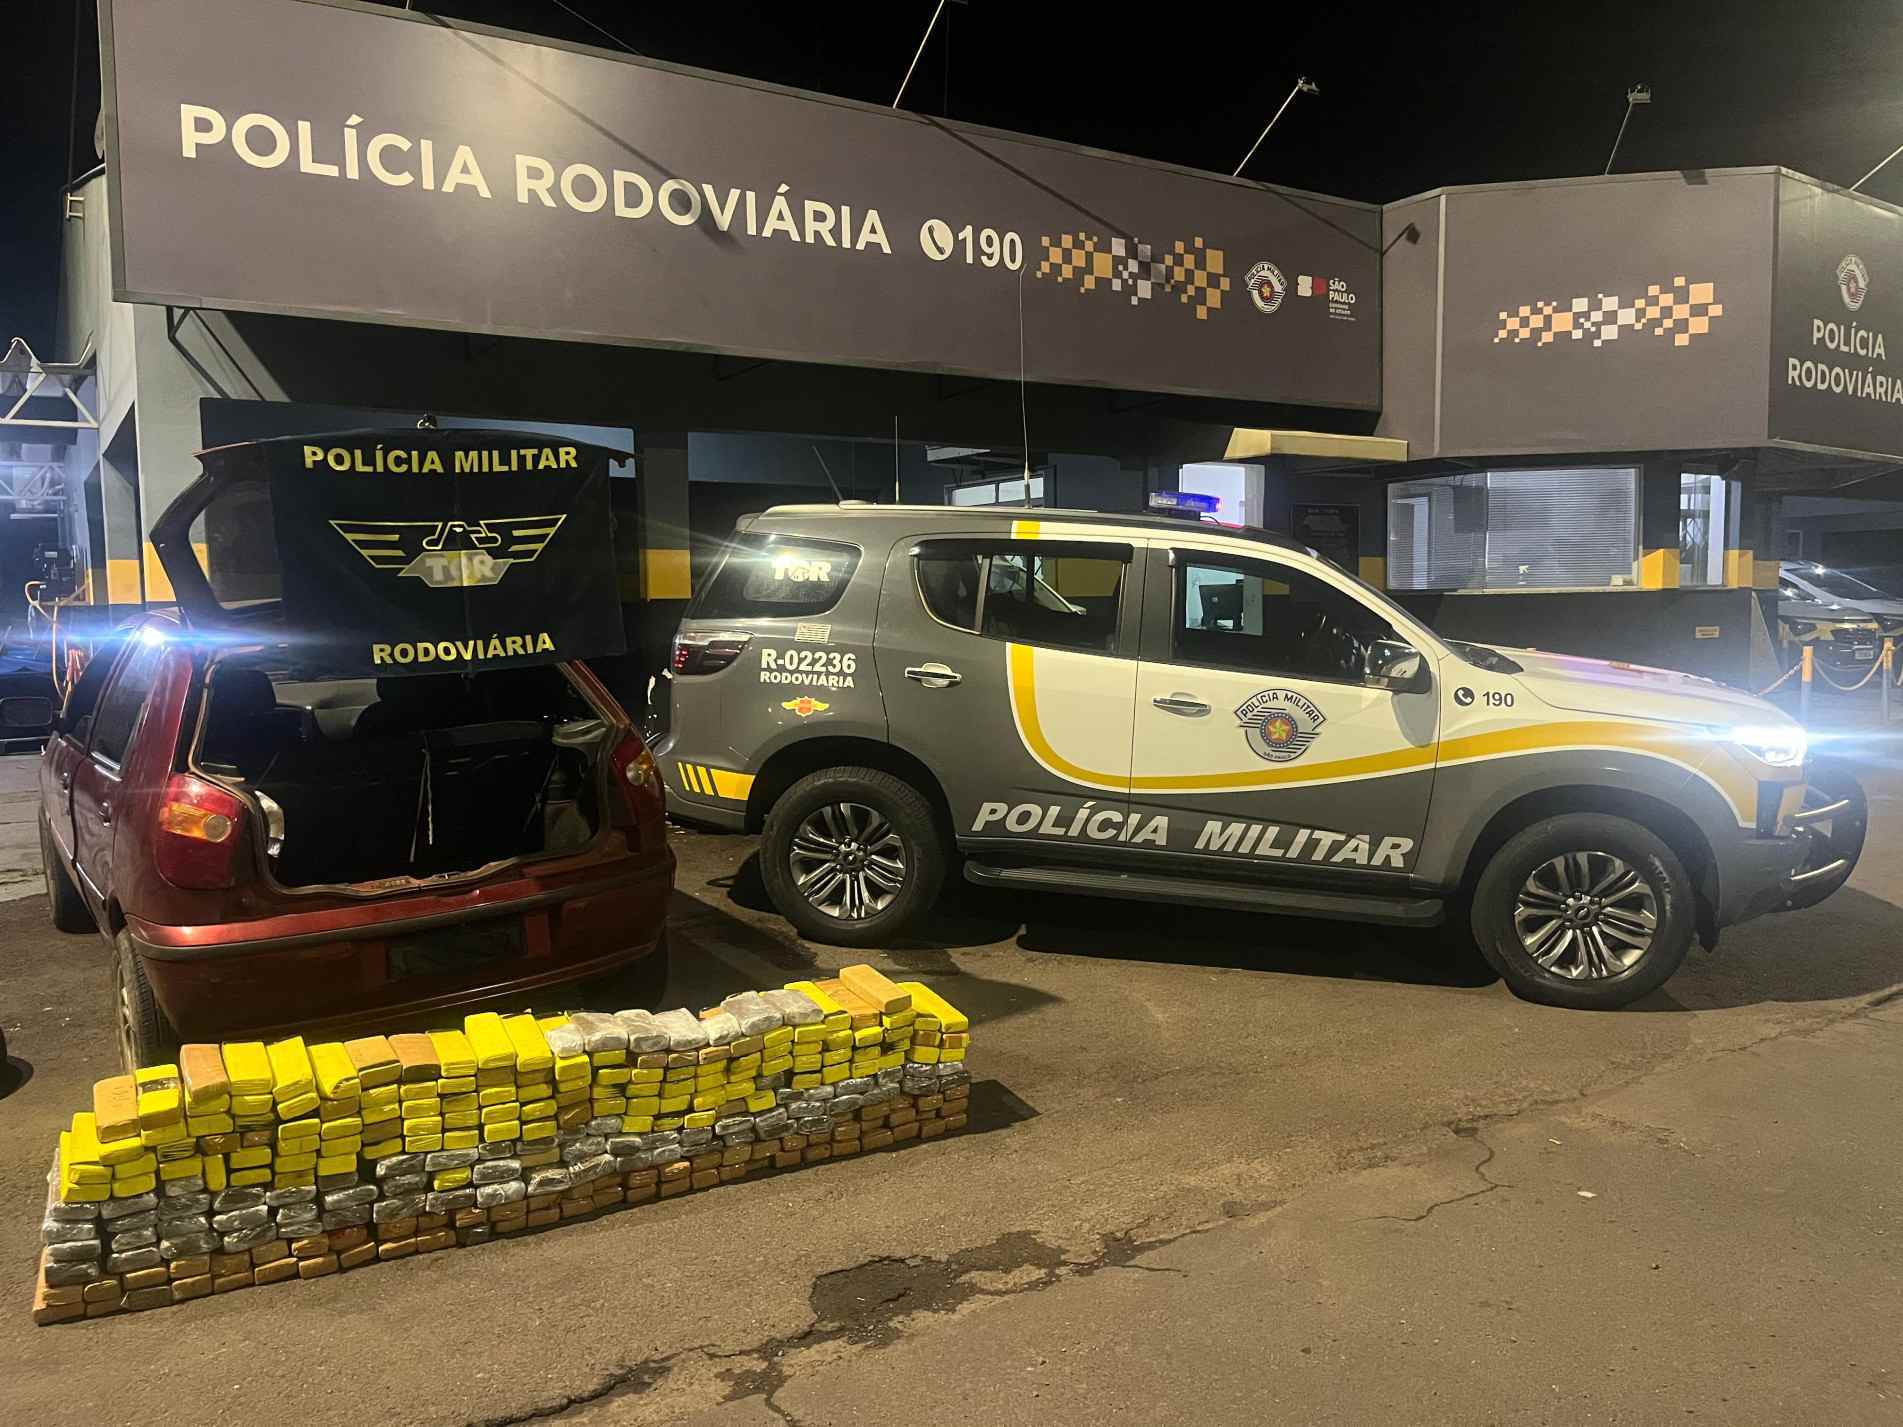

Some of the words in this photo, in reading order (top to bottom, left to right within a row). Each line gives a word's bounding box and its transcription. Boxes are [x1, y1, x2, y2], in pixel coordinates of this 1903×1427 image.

[180, 103, 491, 198] POLÍCIA
[515, 154, 892, 254] RODOVIÁRIA
[958, 225, 1023, 271] 190
[1329, 278, 1346, 291] SÃO
[1329, 291, 1356, 304] PAULO
[1813, 318, 1886, 361] POLÍCIA
[1787, 357, 1903, 405] RODOVIÁRIA
[303, 445, 444, 473] POLÍCIA
[455, 447, 579, 473] MILITAR
[372, 632, 556, 665] RODOVIÁRIA
[760, 648, 857, 674] R-02236
[759, 671, 855, 688] RODOVIÁRIA
[1240, 692, 1279, 718] POLÍCIA
[1283, 693, 1320, 723] MILITAR
[1482, 691, 1515, 707] 190
[971, 801, 1169, 846] POLÍCIA
[1194, 820, 1414, 867] MILITAR
